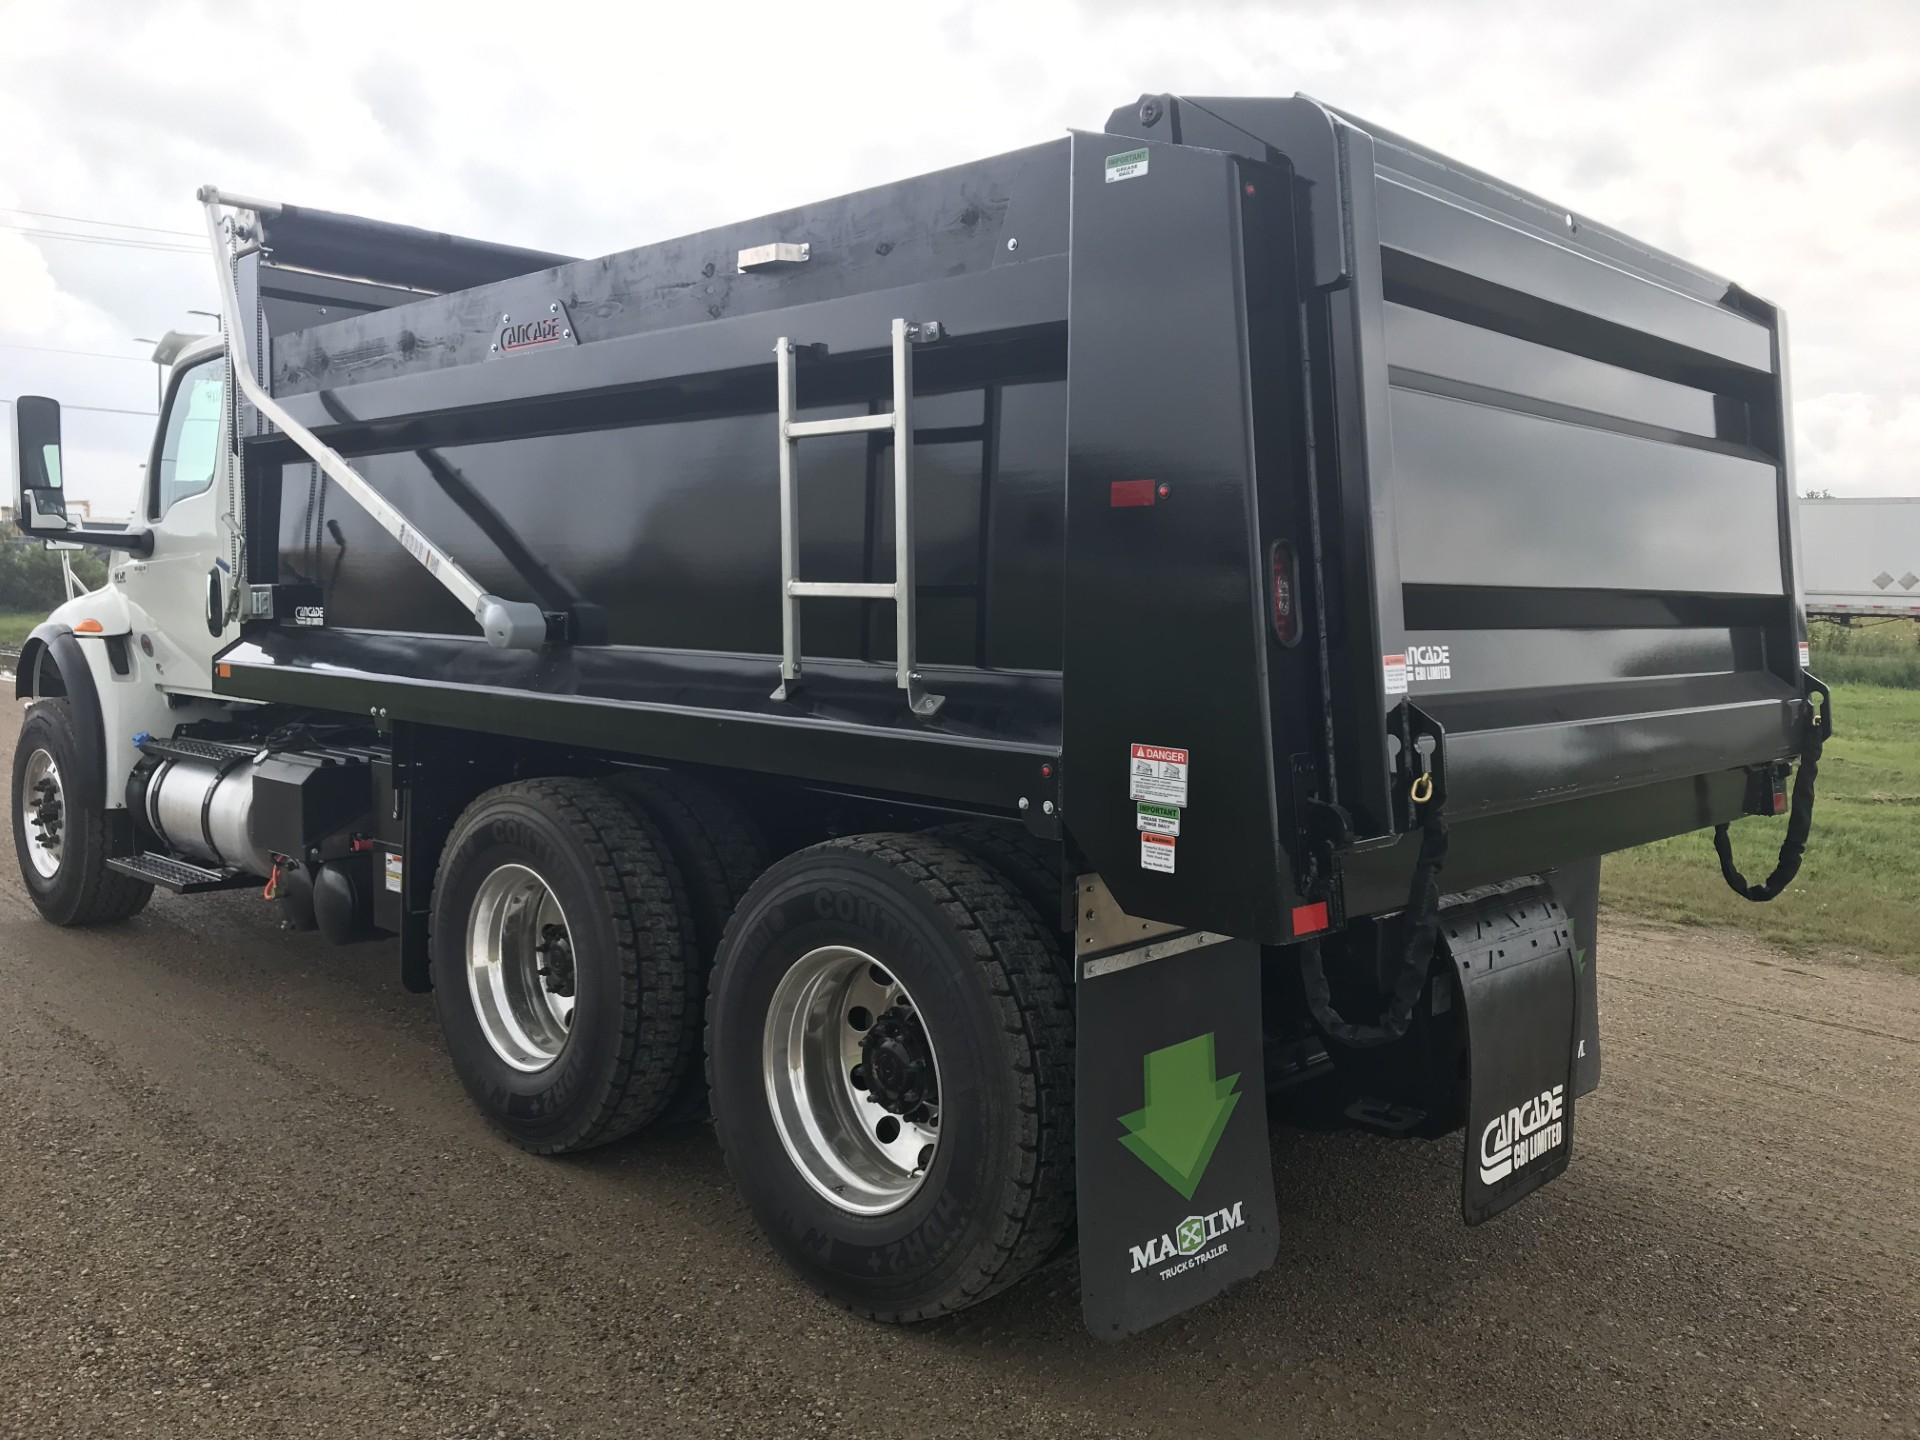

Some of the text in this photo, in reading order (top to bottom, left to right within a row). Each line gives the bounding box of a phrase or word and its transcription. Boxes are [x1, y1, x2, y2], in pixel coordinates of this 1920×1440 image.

[500, 317, 560, 352] CANCADE
[1405, 646, 1450, 665] NCADE
[1146, 749, 1185, 762] DANGER
[1139, 804, 1177, 817] IMPORTANT
[1481, 1084, 1563, 1168] CANCADE
[1529, 1121, 1562, 1161] LIMITED
[1129, 1200, 1245, 1273] MAXIM
[1160, 1261, 1189, 1281] TRUCK
[1194, 1243, 1229, 1267] TRAILER
